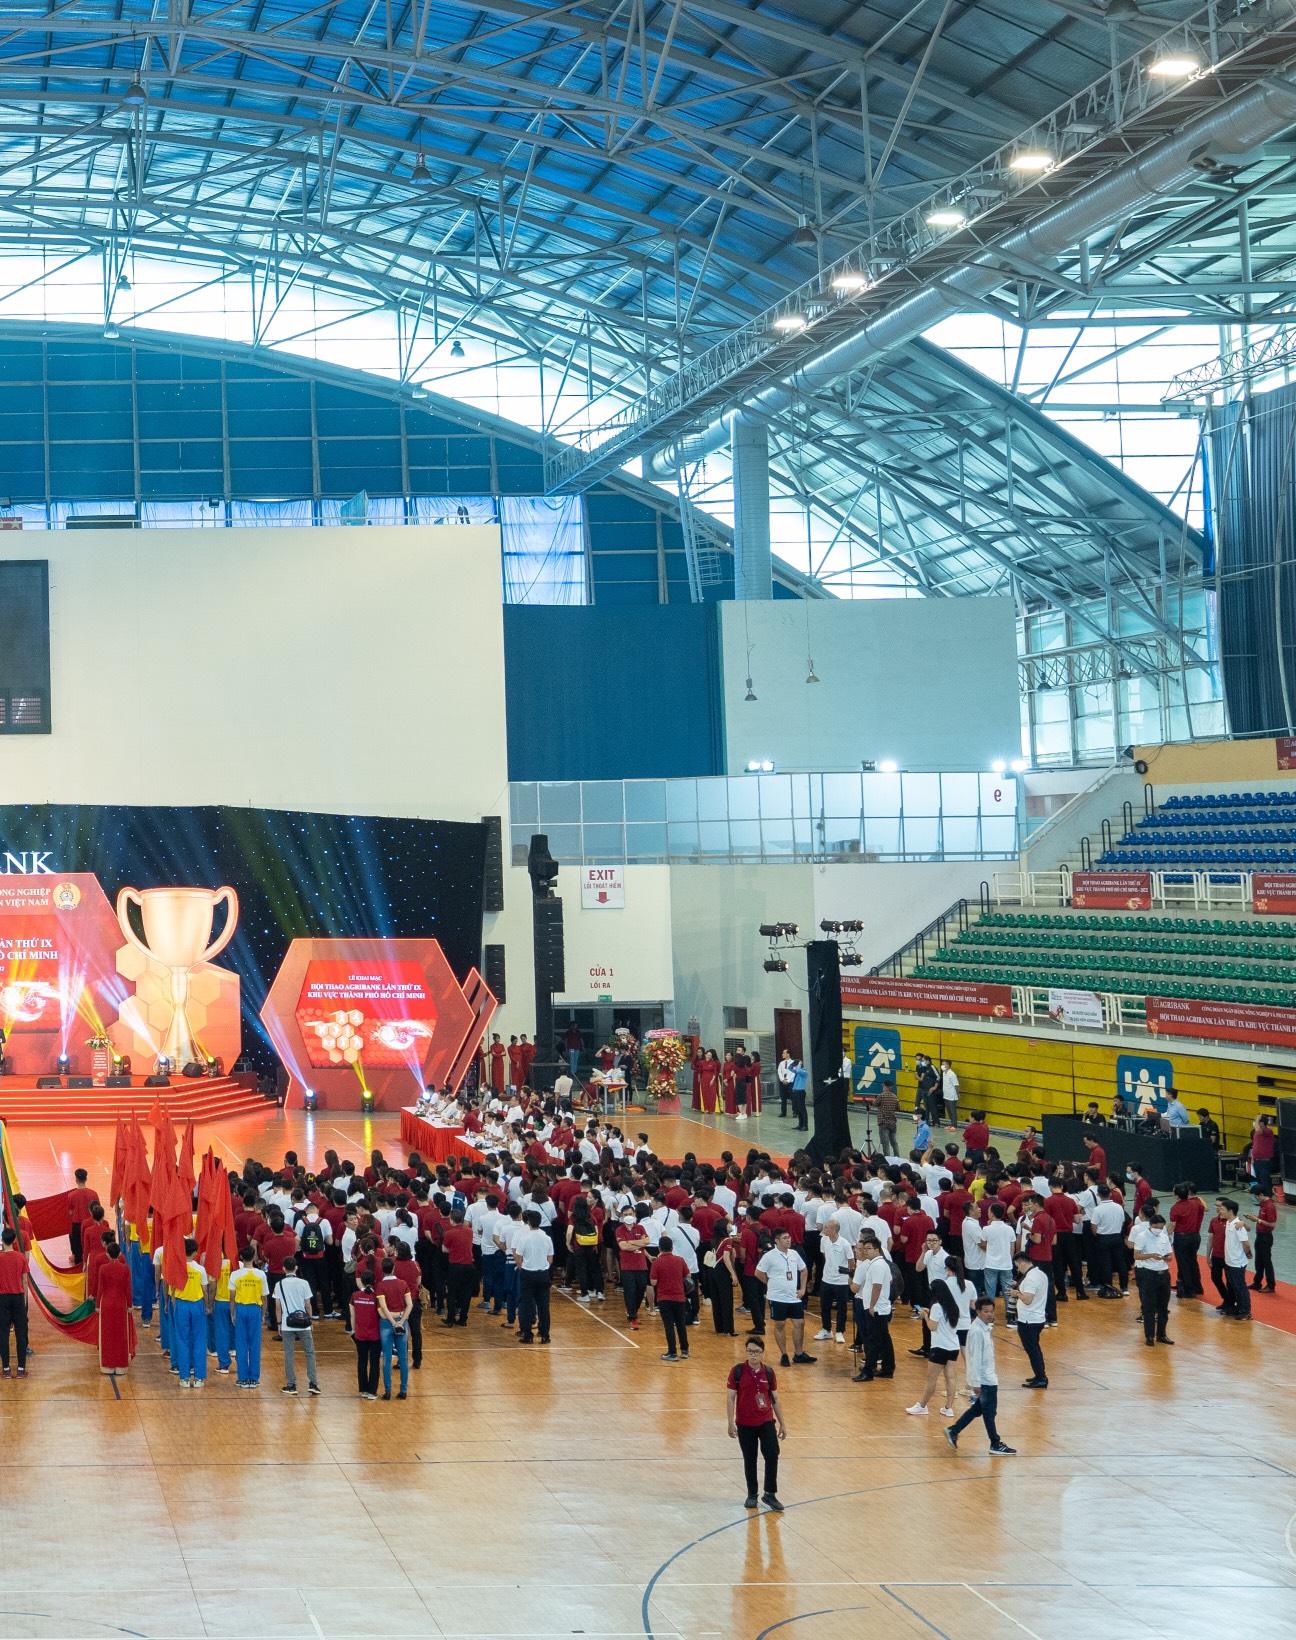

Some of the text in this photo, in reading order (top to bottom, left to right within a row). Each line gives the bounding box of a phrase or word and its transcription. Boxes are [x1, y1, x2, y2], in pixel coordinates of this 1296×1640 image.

[589, 870, 615, 880] EXIT
[584, 881, 592, 889] LỐI
[17, 888, 51, 897] NGHIỆP
[5, 898, 26, 907] VIỆT
[28, 898, 49, 906] NAM
[15, 937, 39, 948] THỨ
[41, 939, 53, 948] IX
[7, 949, 27, 960] CHÍ
[29, 951, 58, 960] MINH
[590, 964, 614, 976] CỬA 1
[590, 980, 600, 988] LỐI
[1160, 1001, 1190, 1010] AGRIBANK
